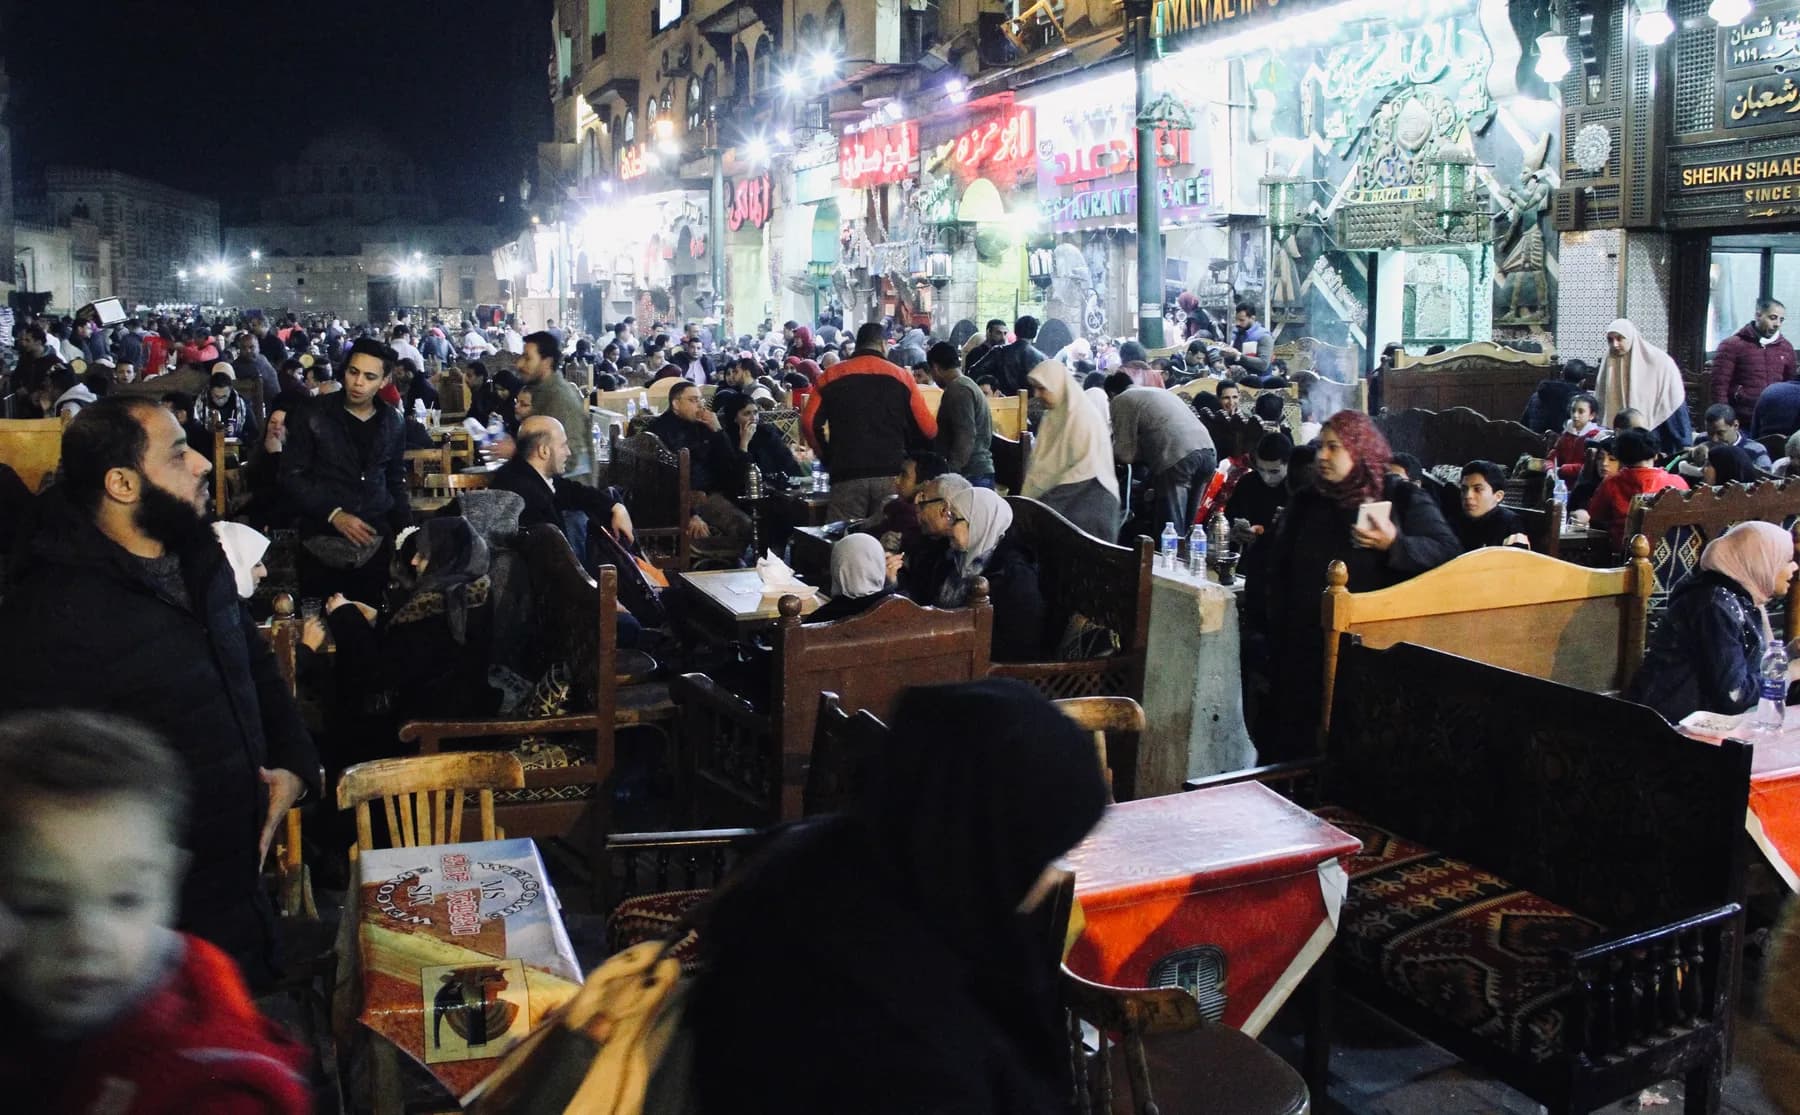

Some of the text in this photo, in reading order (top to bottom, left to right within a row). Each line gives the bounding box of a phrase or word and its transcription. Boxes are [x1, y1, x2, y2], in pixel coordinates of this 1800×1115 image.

[1731, 16, 1772, 45] شعبان
[1731, 78, 1798, 120] شعبان
[1682, 164, 1743, 186] SHEIKH
[1745, 186, 1792, 203] SINCE
[376, 866, 433, 925] WELCOME
[477, 861, 540, 920] WELCOME
